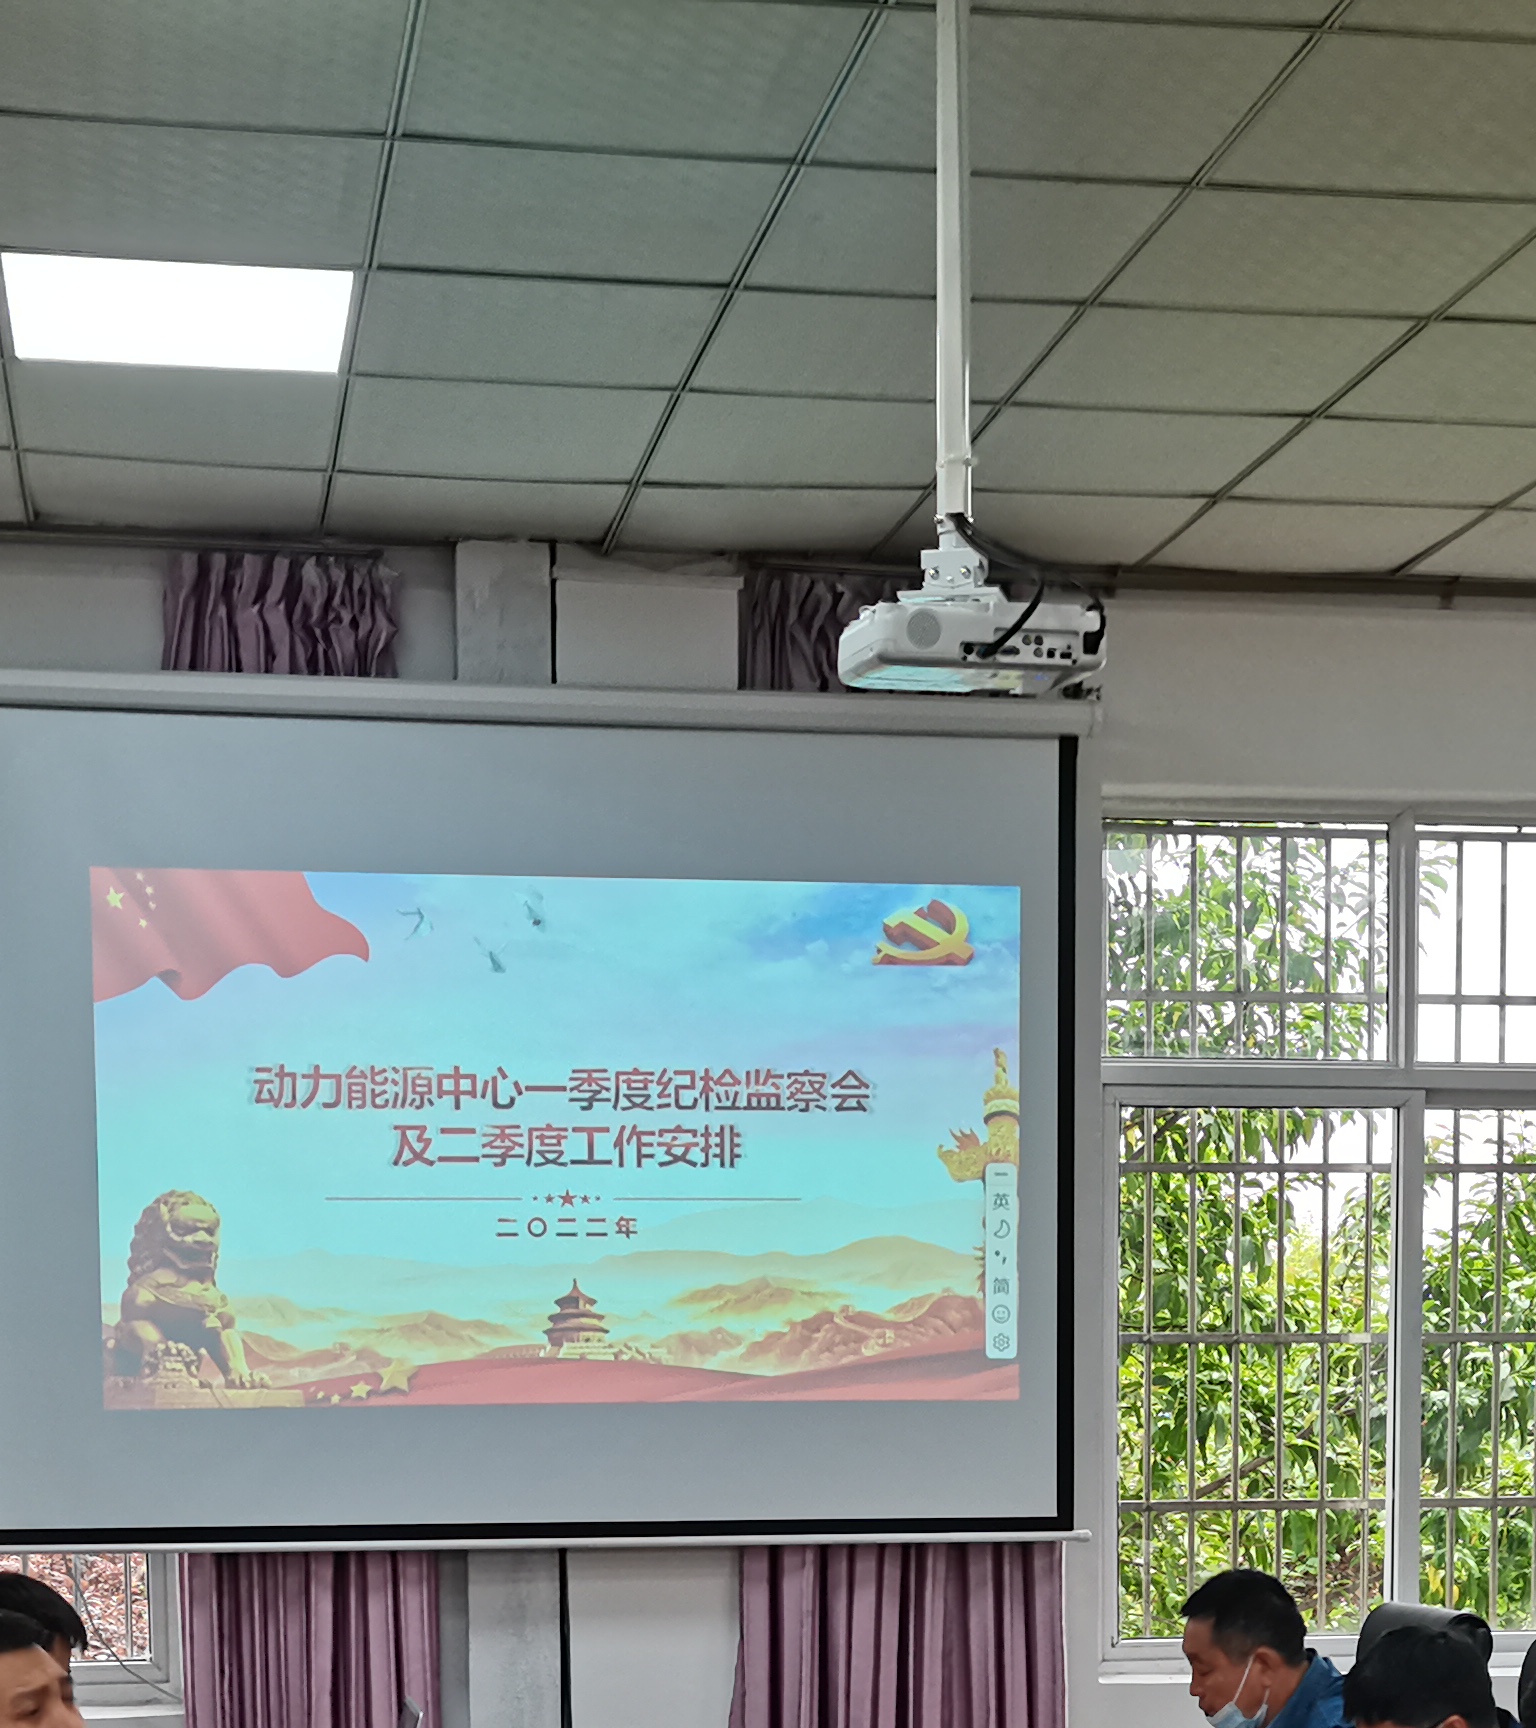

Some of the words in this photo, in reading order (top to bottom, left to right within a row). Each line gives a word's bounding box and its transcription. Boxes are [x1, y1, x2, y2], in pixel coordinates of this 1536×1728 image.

[251, 1064, 873, 1114] 动力能源中心一季度纪检监察会
[389, 1123, 743, 1169] 及二季度工作安排
